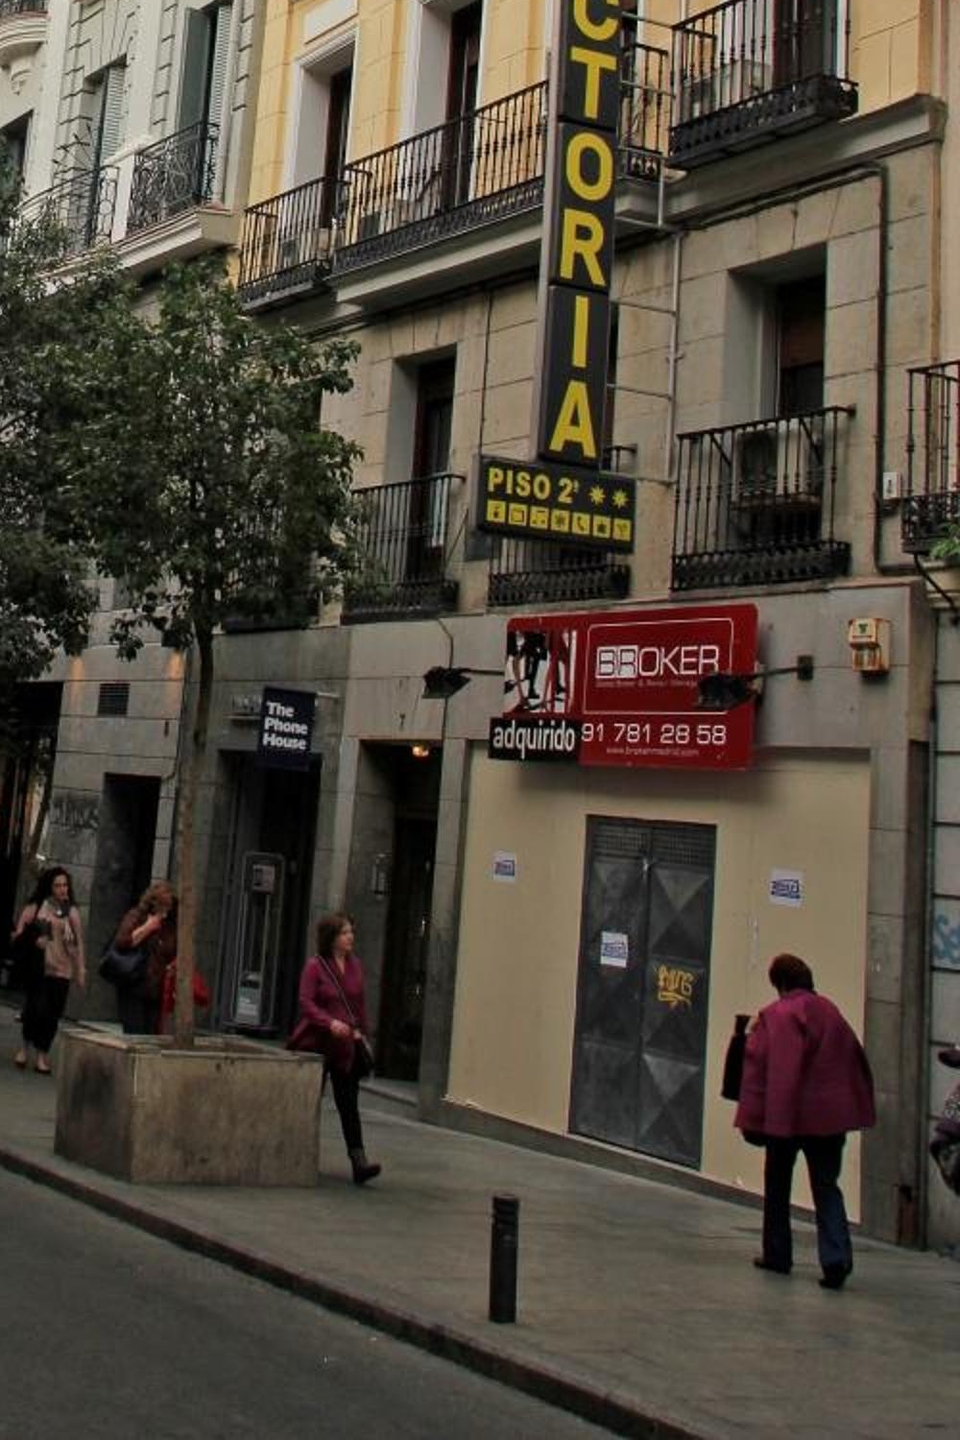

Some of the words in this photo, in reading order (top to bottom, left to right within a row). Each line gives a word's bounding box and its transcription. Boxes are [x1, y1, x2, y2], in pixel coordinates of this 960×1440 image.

[487, 467, 551, 500] PISO
[595, 645, 720, 679] BROKER
[266, 700, 295, 717] The
[264, 716, 308, 735] Phone
[581, 723, 604, 742] 91
[614, 723, 650, 744] 781
[660, 724, 690, 744] 28
[696, 724, 727, 745] 58
[262, 732, 307, 750] House
[493, 719, 575, 760] adquirido
